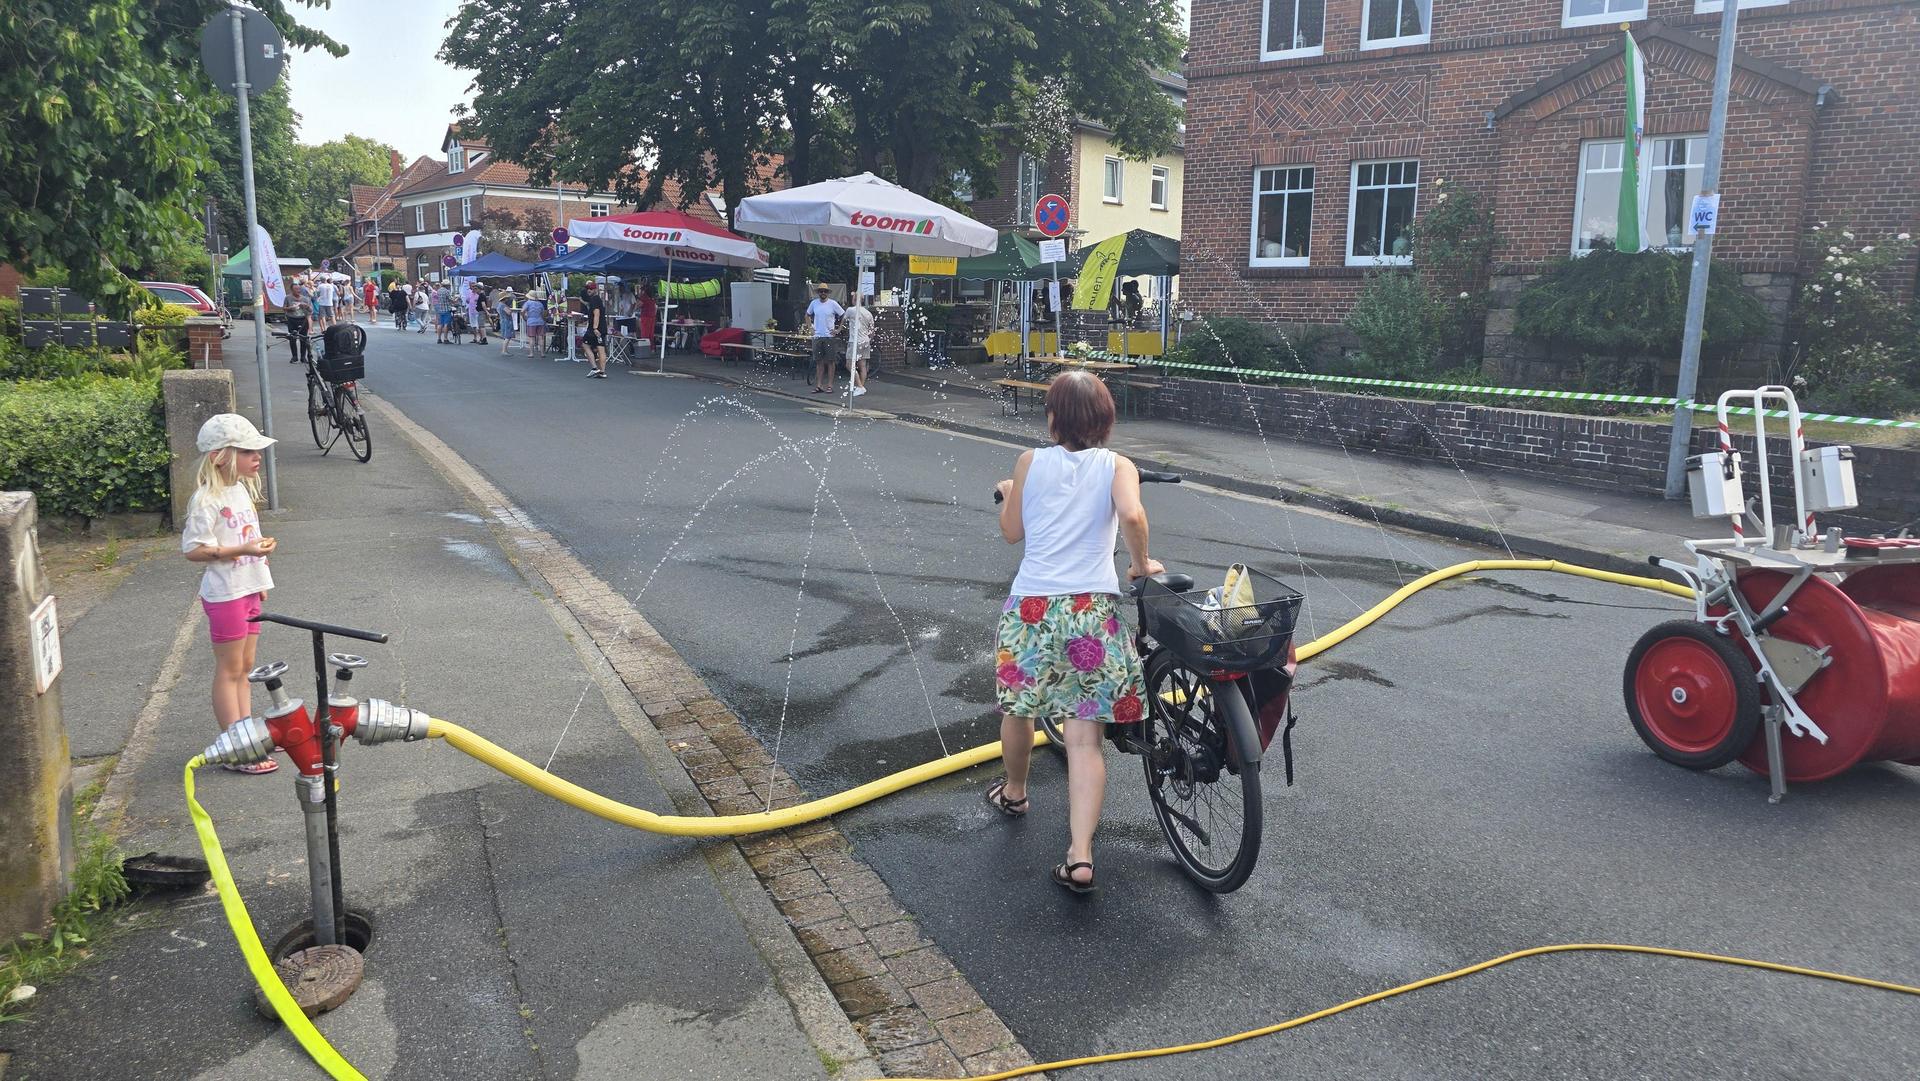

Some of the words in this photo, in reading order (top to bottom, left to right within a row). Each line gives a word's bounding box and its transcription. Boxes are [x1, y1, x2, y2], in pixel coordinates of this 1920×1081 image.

[850, 210, 916, 233] toom
[1694, 211, 1713, 222] WC
[623, 226, 669, 241] toom
[456, 247, 462, 255] P
[558, 246, 566, 255] P
